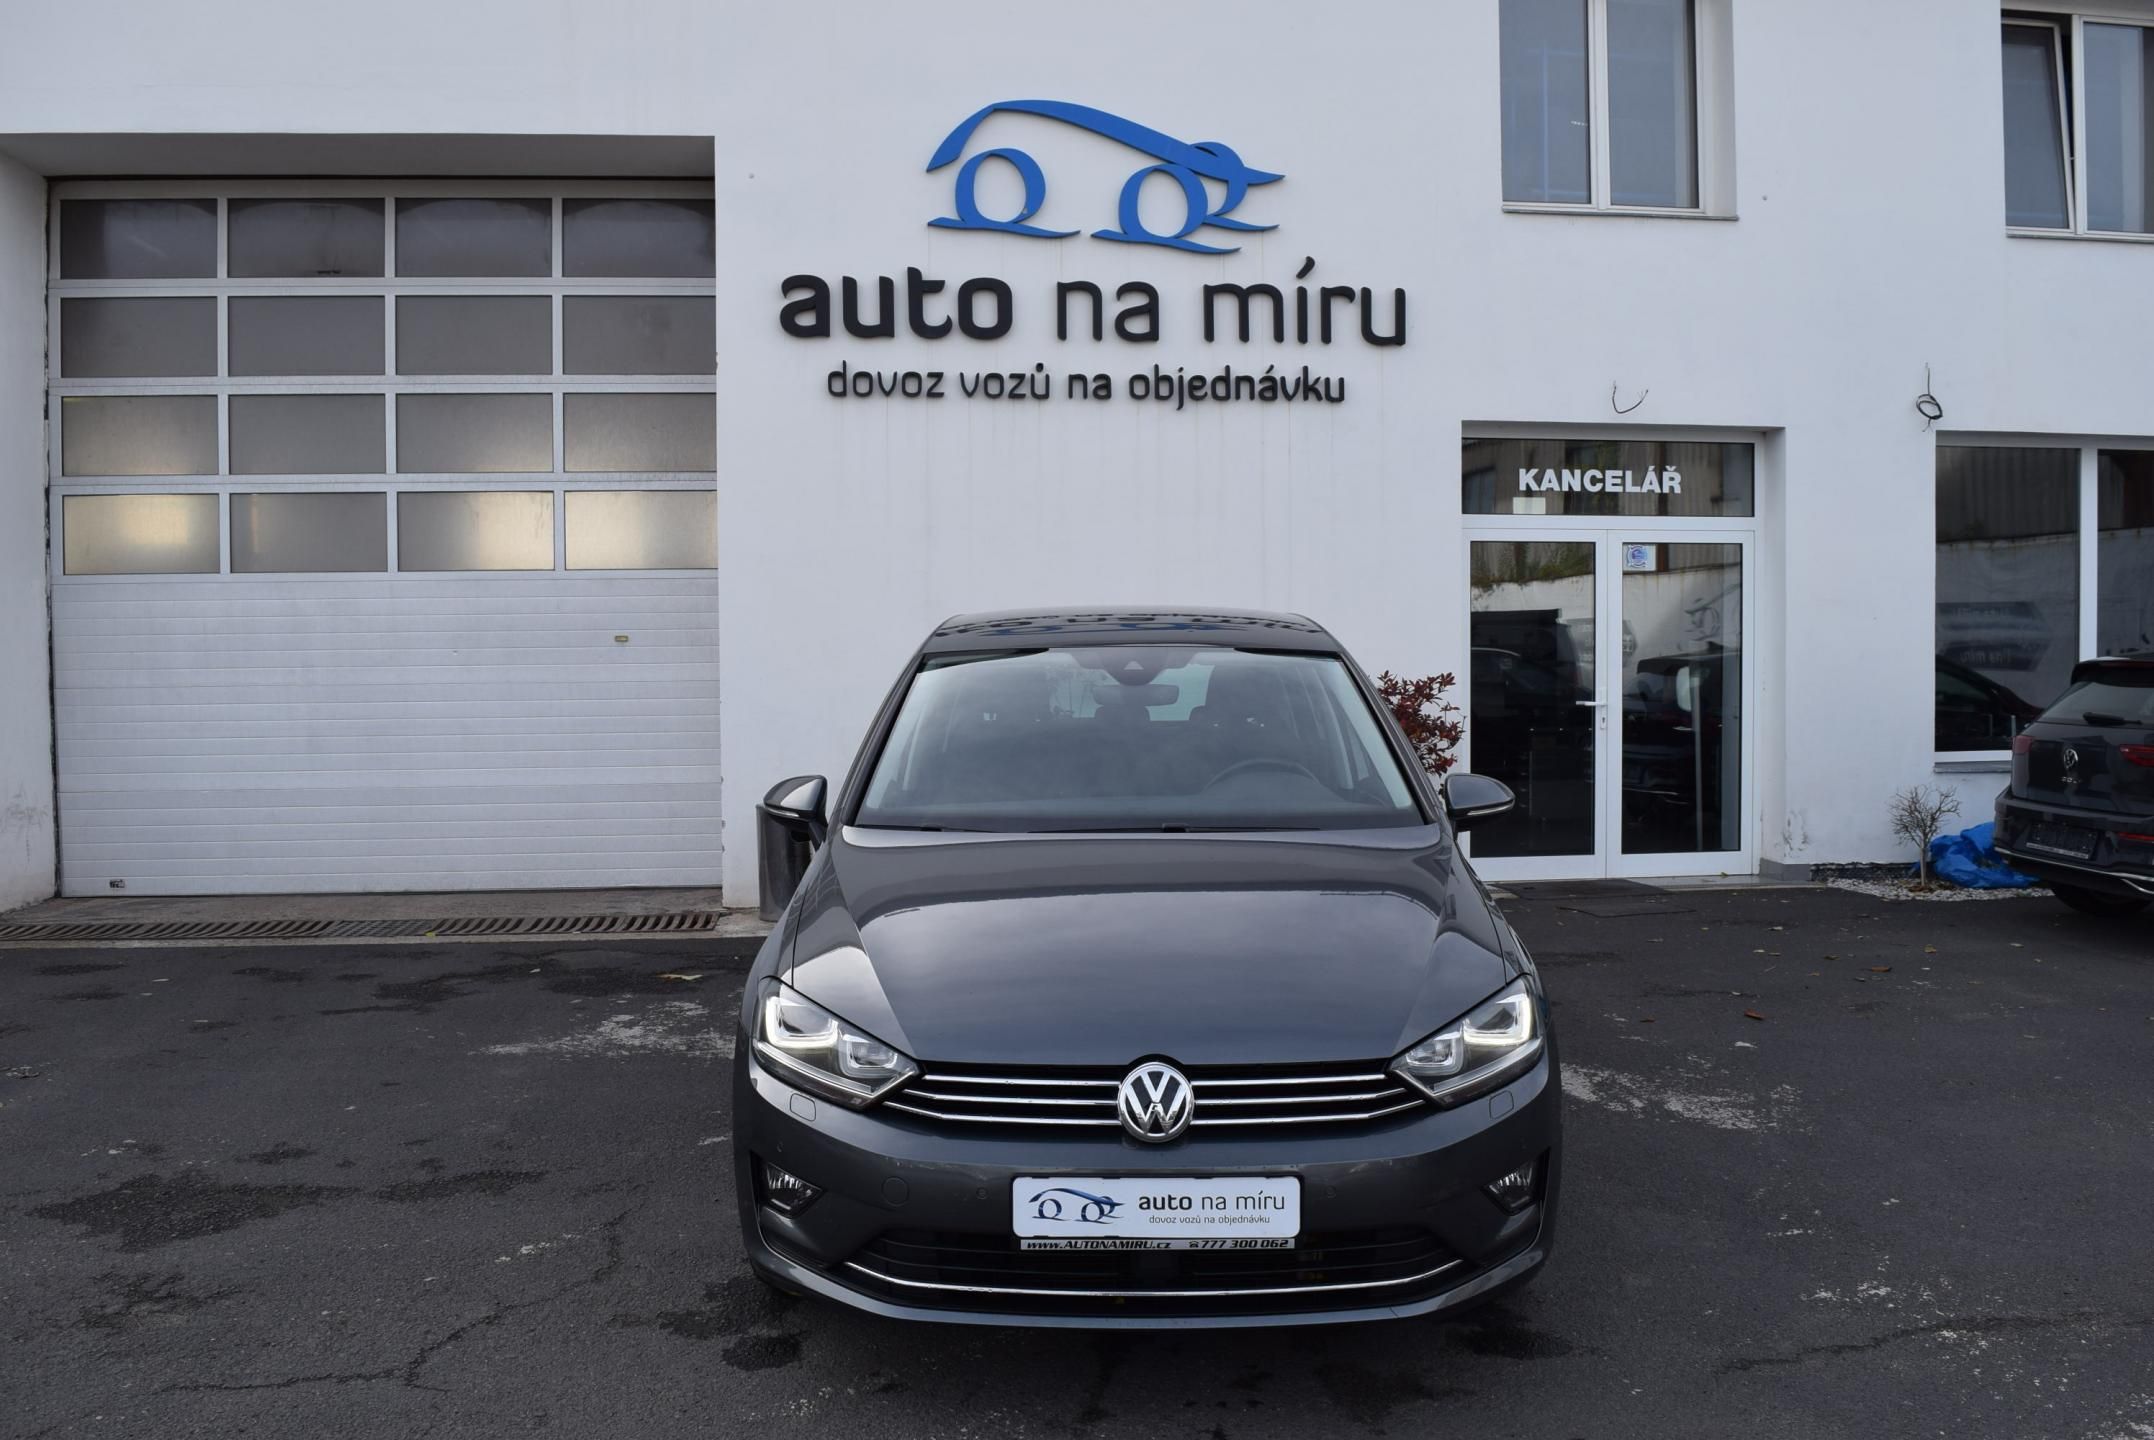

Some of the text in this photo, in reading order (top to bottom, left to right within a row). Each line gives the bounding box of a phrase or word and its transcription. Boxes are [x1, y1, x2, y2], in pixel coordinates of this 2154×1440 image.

[780, 256, 1407, 347] auto na míru
[827, 360, 1345, 411] dovoz vozů na objednávku
[1518, 465, 1682, 494] KANCELÁŘ
[1138, 1189, 1286, 1211] auto na míru
[1148, 1214, 1271, 1226] dovoz vozů na objednávku
[1230, 1239, 1258, 1249] 300
[1260, 1239, 1289, 1249] 062
